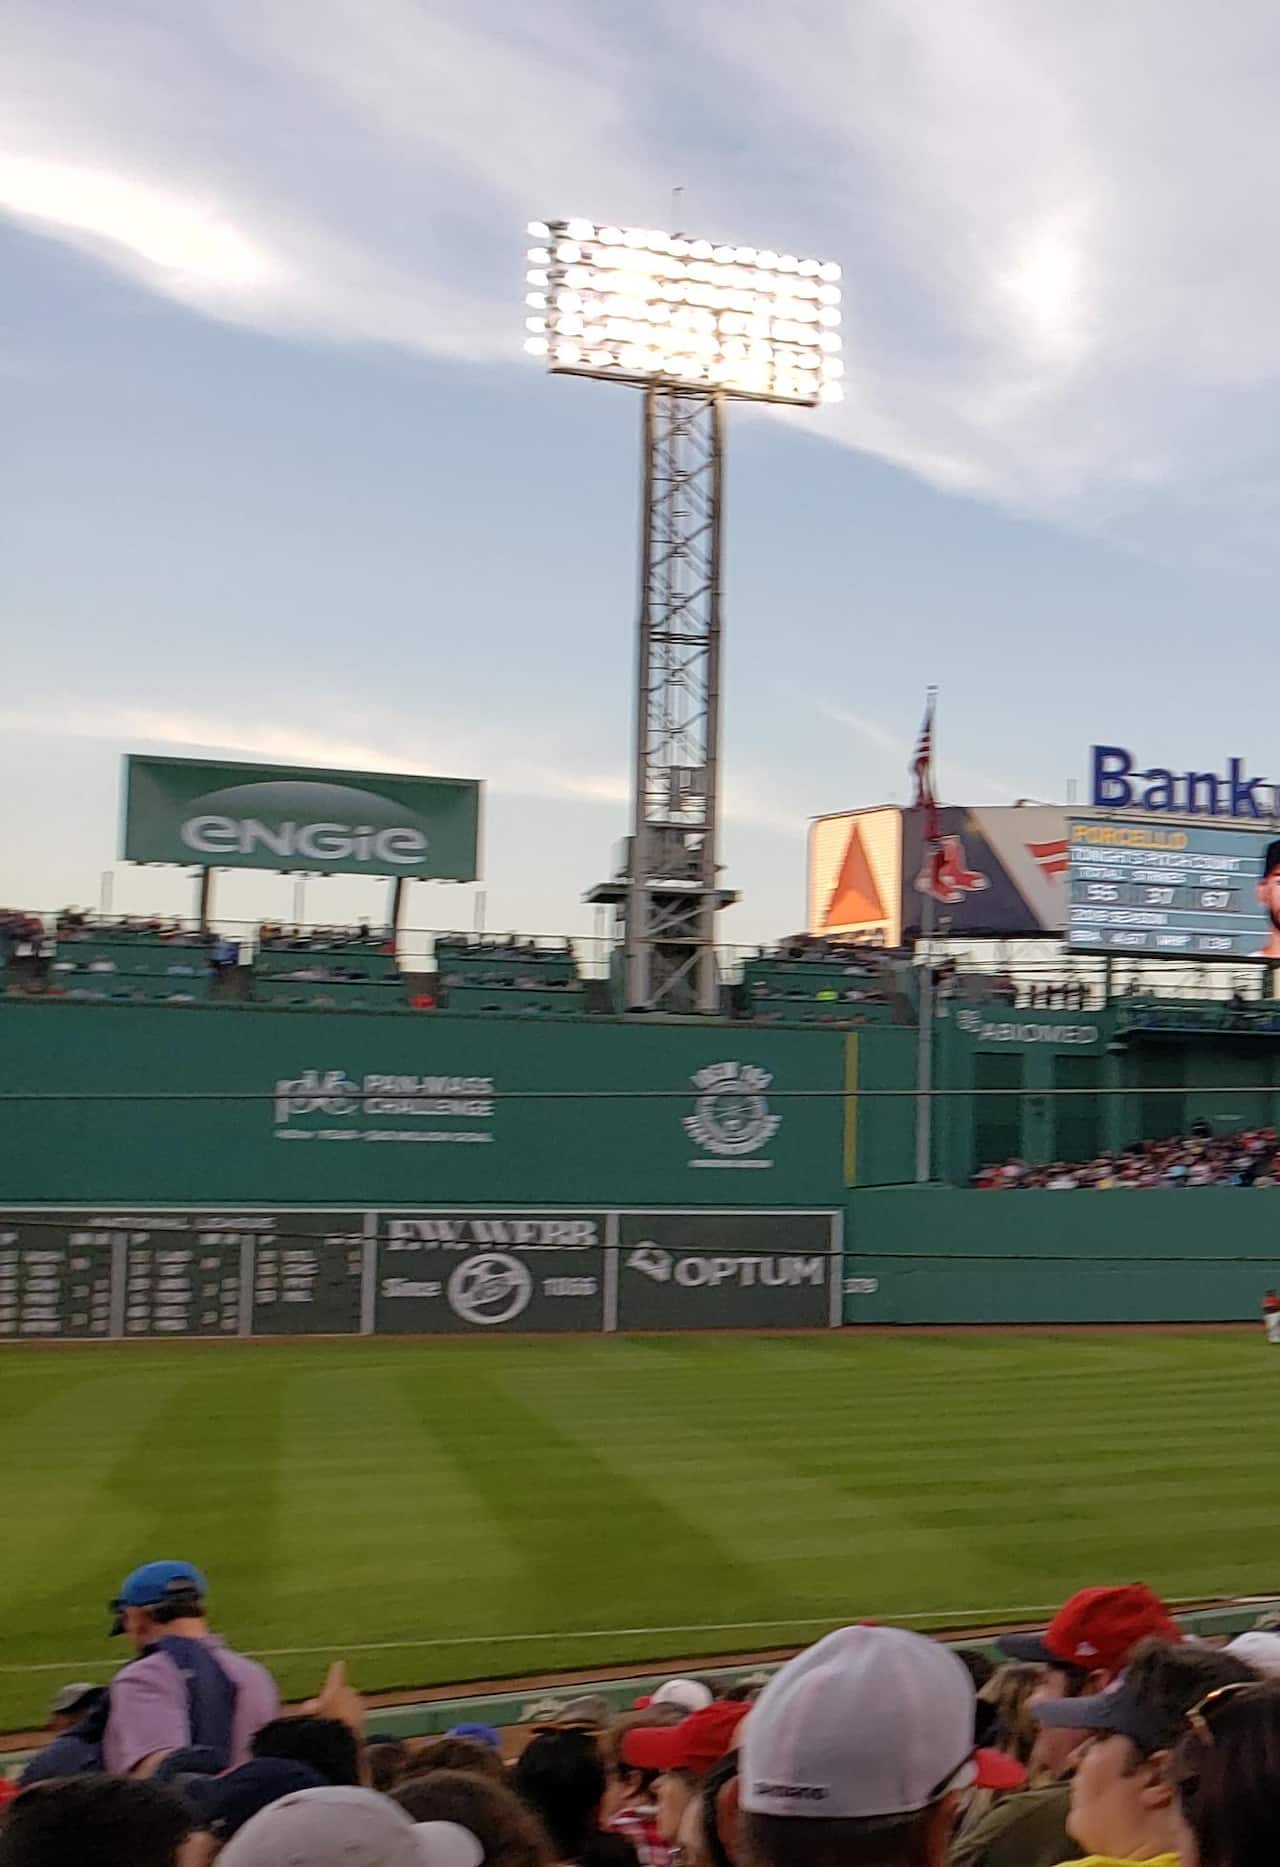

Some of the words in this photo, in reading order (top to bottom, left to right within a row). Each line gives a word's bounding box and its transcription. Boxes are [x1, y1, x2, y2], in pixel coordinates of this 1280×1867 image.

[1090, 744, 1263, 817] Bank
[1072, 826, 1188, 850] PORCELLO
[1144, 887, 1175, 904] 37
[1200, 891, 1231, 908] 67
[363, 1075, 494, 1095] PAN-MASS
[363, 1097, 497, 1117] CHALLENGE
[470, 1219, 598, 1251] WEBB
[674, 1254, 825, 1287] OPTUM
